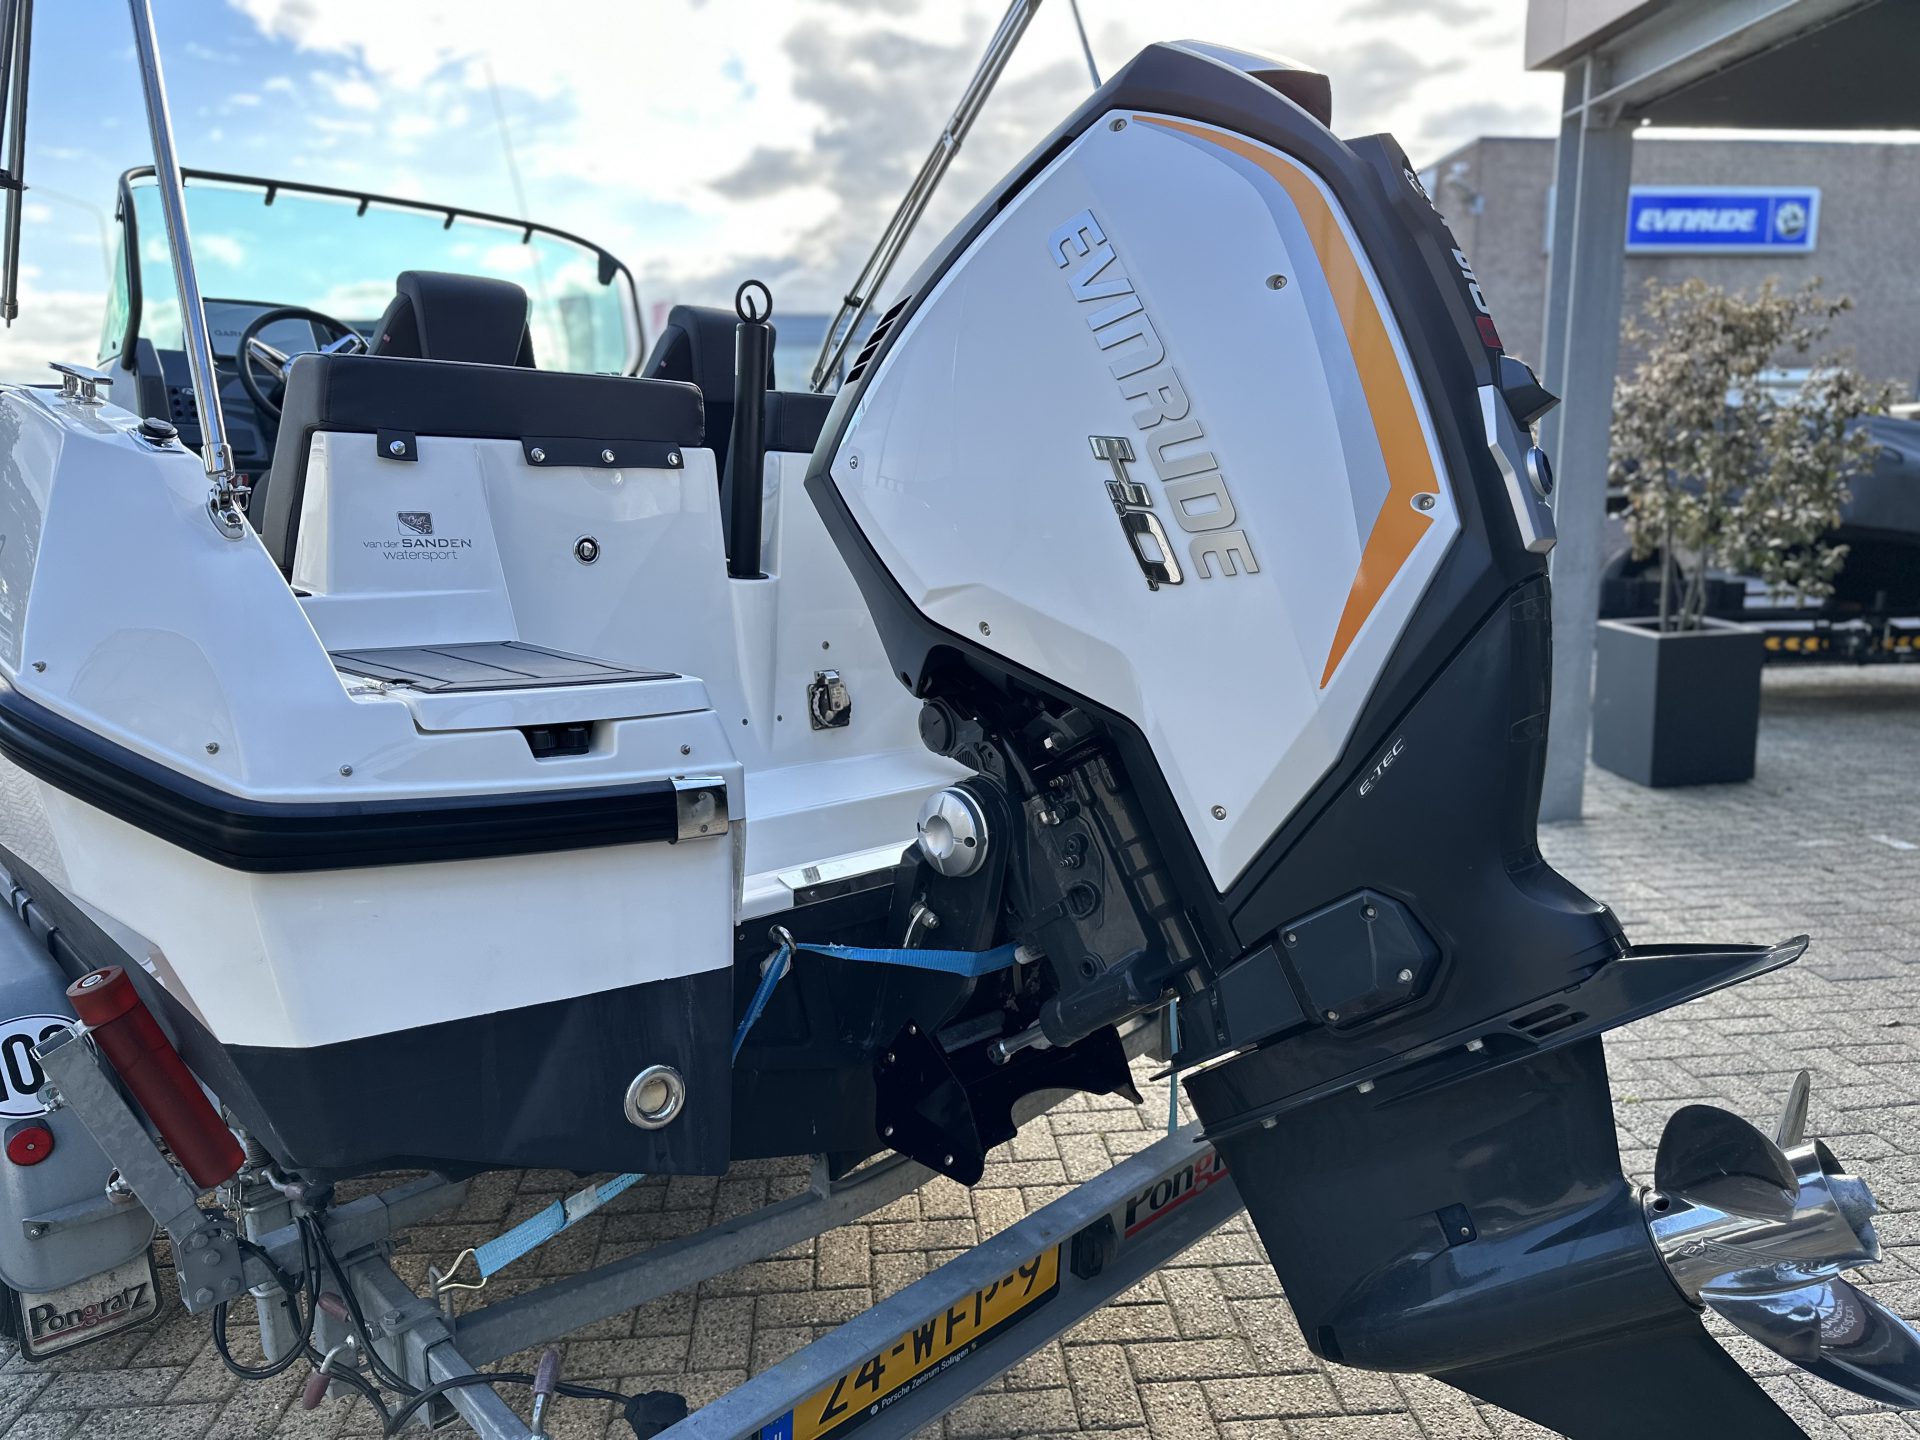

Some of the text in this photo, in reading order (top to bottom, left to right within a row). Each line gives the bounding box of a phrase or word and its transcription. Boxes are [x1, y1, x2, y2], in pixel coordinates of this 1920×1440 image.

[1048, 209, 1260, 579] EVINRUDE
[363, 538, 472, 549] van der SANDEN
[383, 549, 458, 562] watersport
[1359, 738, 1404, 796] E-TEC
[30, 1283, 149, 1338] Pongratz
[881, 1346, 970, 1410] Porsche Zentrum Solingen
